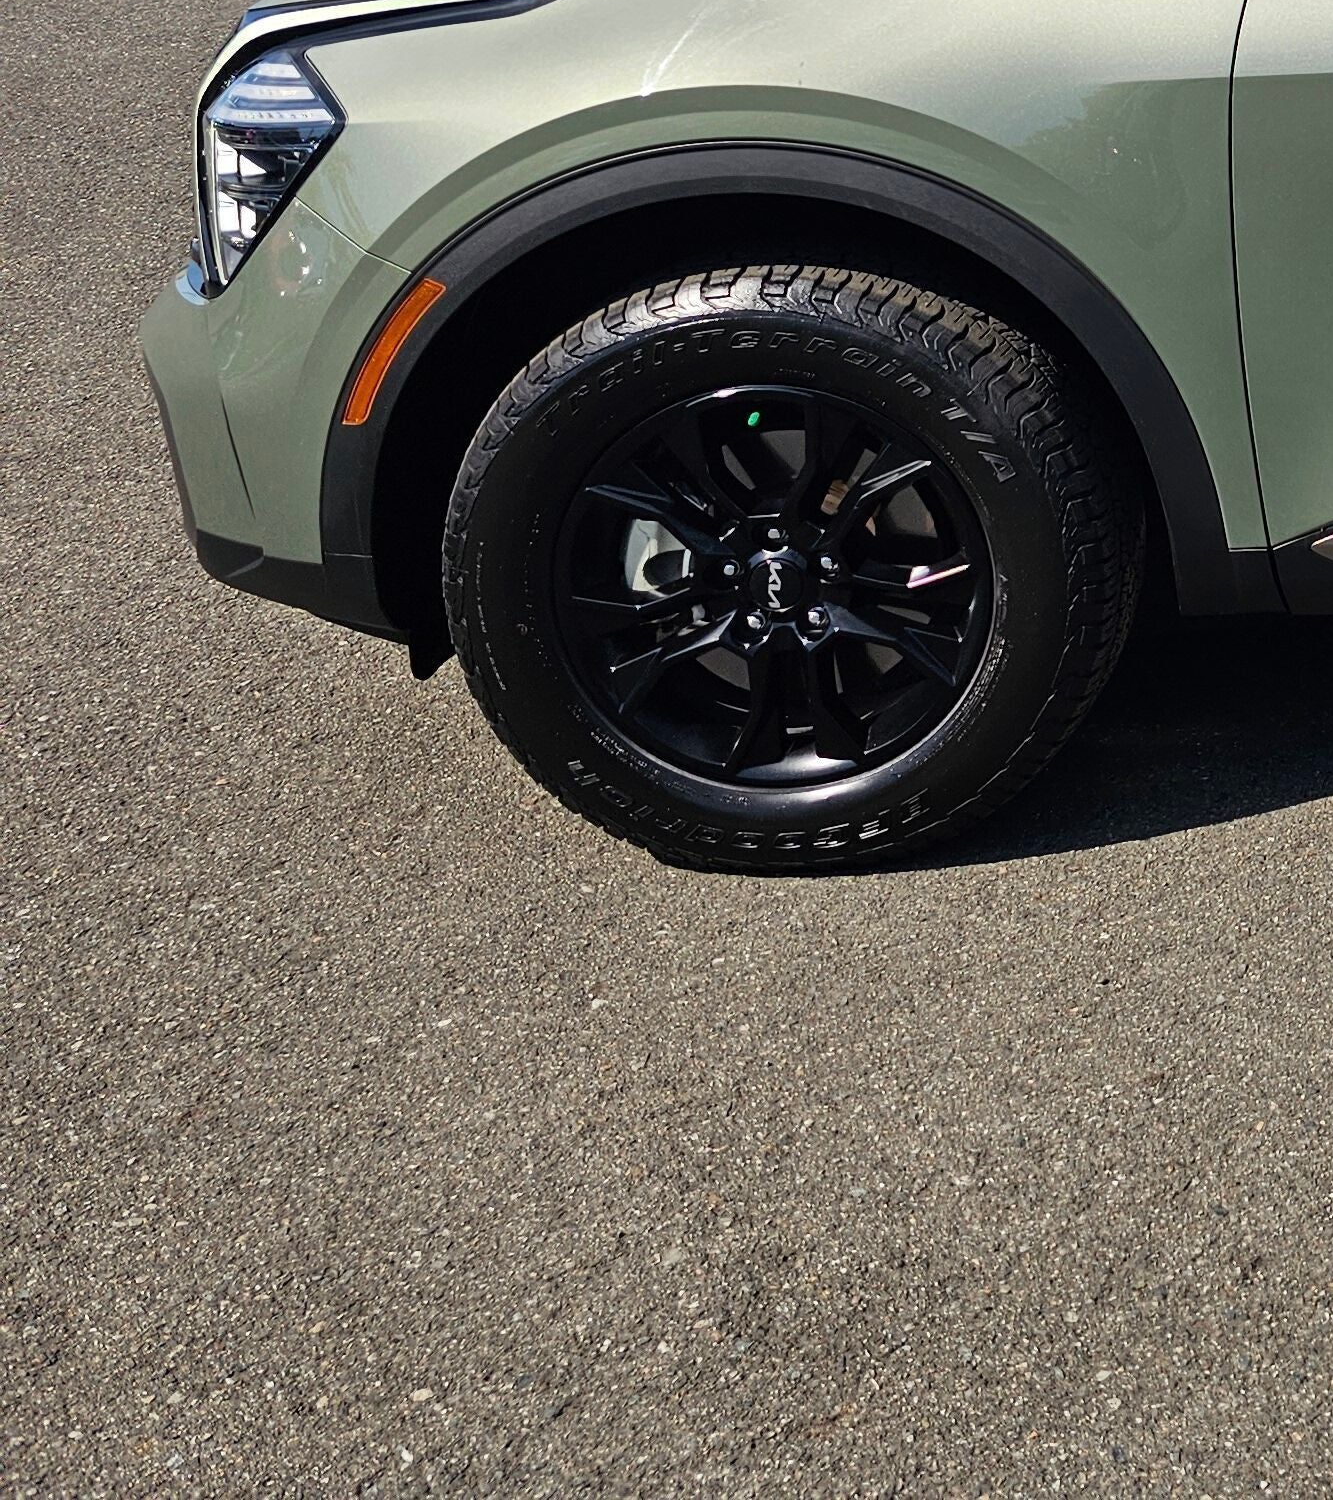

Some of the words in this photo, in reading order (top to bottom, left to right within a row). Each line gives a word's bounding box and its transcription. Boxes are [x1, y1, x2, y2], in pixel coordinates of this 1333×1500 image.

[535, 326, 933, 437] Trail-Terrain
[940, 397, 1017, 483] T/A
[567, 758, 931, 850] BFGoodrich
